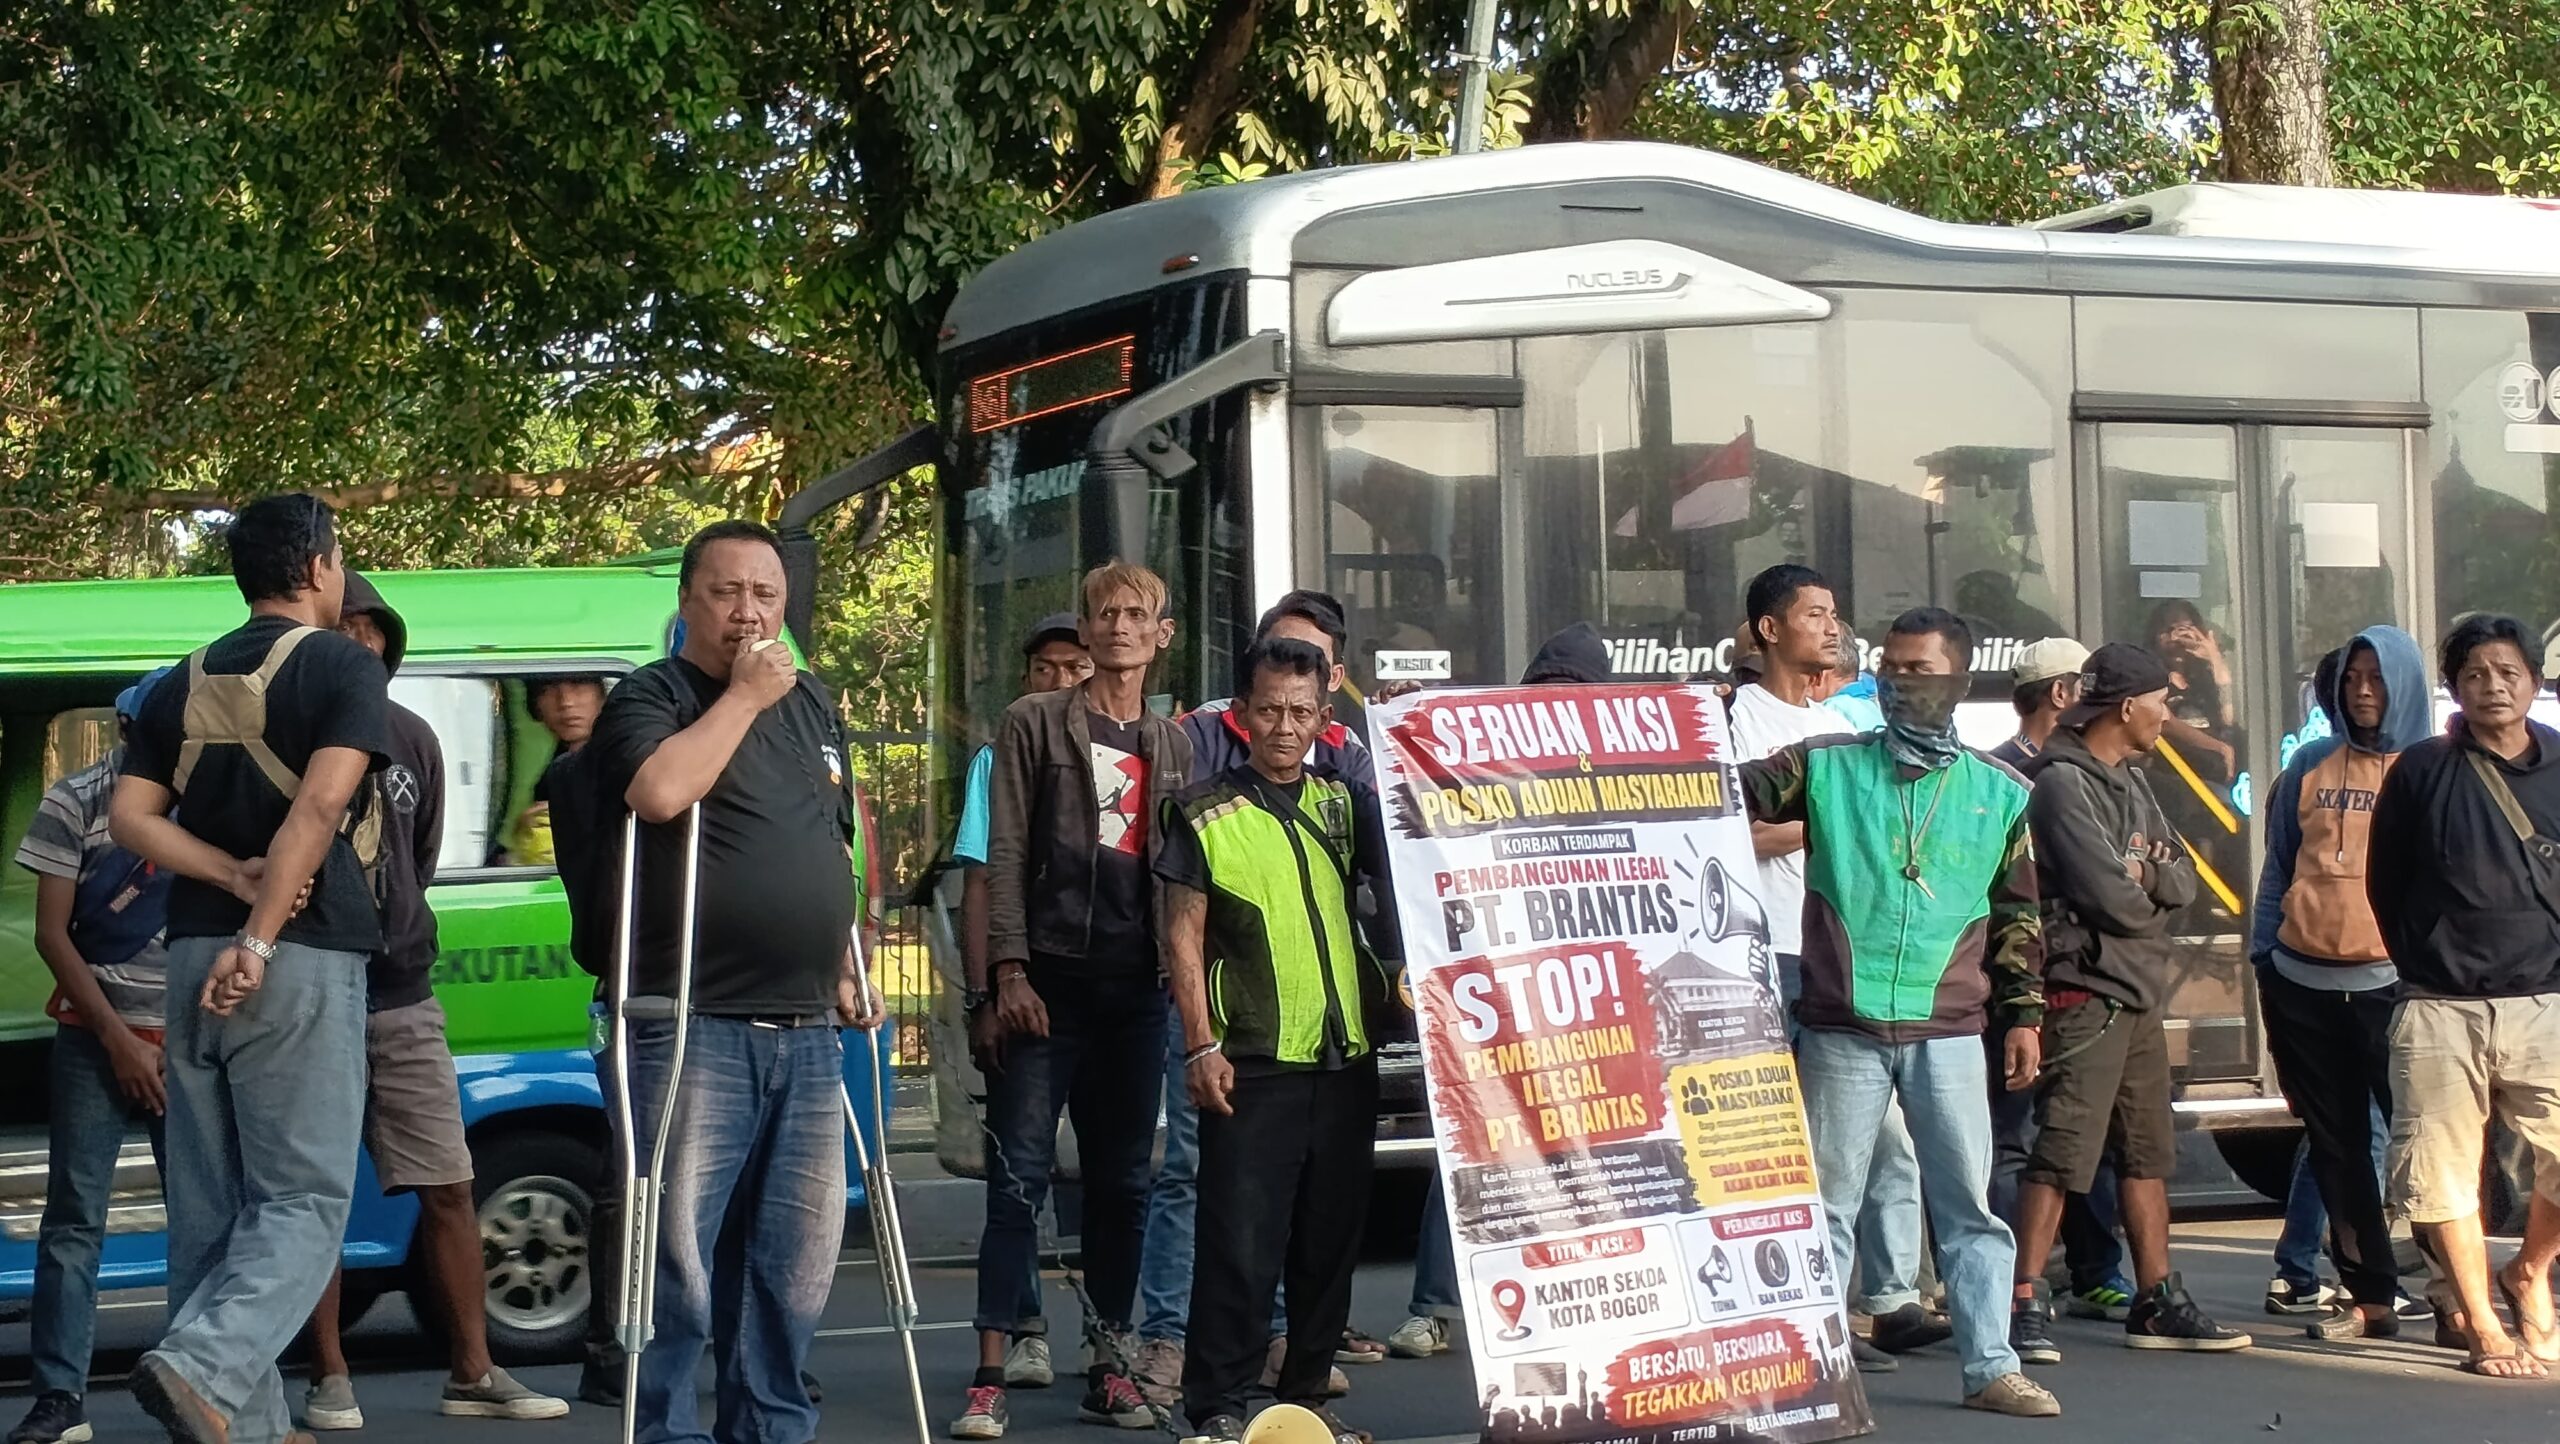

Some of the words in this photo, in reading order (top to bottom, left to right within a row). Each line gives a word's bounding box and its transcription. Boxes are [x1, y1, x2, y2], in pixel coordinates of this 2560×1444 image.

[1567, 269, 1662, 288] NUCLEUS
[1431, 699, 1592, 766] SERUAN
[1593, 696, 1680, 753] AKSI
[1578, 750, 1592, 772] &
[1420, 783, 1517, 829] POSKO
[1518, 777, 1597, 817] ADUAN
[1596, 772, 1723, 811] MASYARAKAT
[1501, 835, 1560, 855] KORBAN
[1562, 833, 1631, 851] TERDAMPAK
[1434, 859, 1610, 898] PEMBANGUNAN
[1613, 856, 1670, 881] ILEGAL
[1442, 895, 1516, 952] PT.
[1524, 883, 1679, 941] BRANTAS
[1452, 951, 1625, 1043] STOP!
[1464, 1024, 1635, 1082] PEMBANGUNAN
[1521, 1064, 1607, 1107] ILEGAL
[1709, 1069, 1753, 1091] POSKO
[1485, 1115, 1533, 1152] PT.
[1539, 1093, 1648, 1142] BRANTAS
[1547, 1243, 1586, 1262] TITIK
[1590, 1236, 1624, 1256] AKSI
[1534, 1275, 1609, 1306] KANTOR
[1613, 1266, 1668, 1294] SEKDA
[1549, 1303, 1595, 1330] KOTA
[1601, 1293, 1660, 1321] BOGOR
[1629, 1346, 1711, 1383] BERSATU,
[1713, 1330, 1791, 1366] BERSUARA,
[1622, 1377, 1727, 1420] TEGAKKAN
[1731, 1358, 1808, 1398] KEADILAN!
[1672, 1424, 1717, 1442] TERTIB
